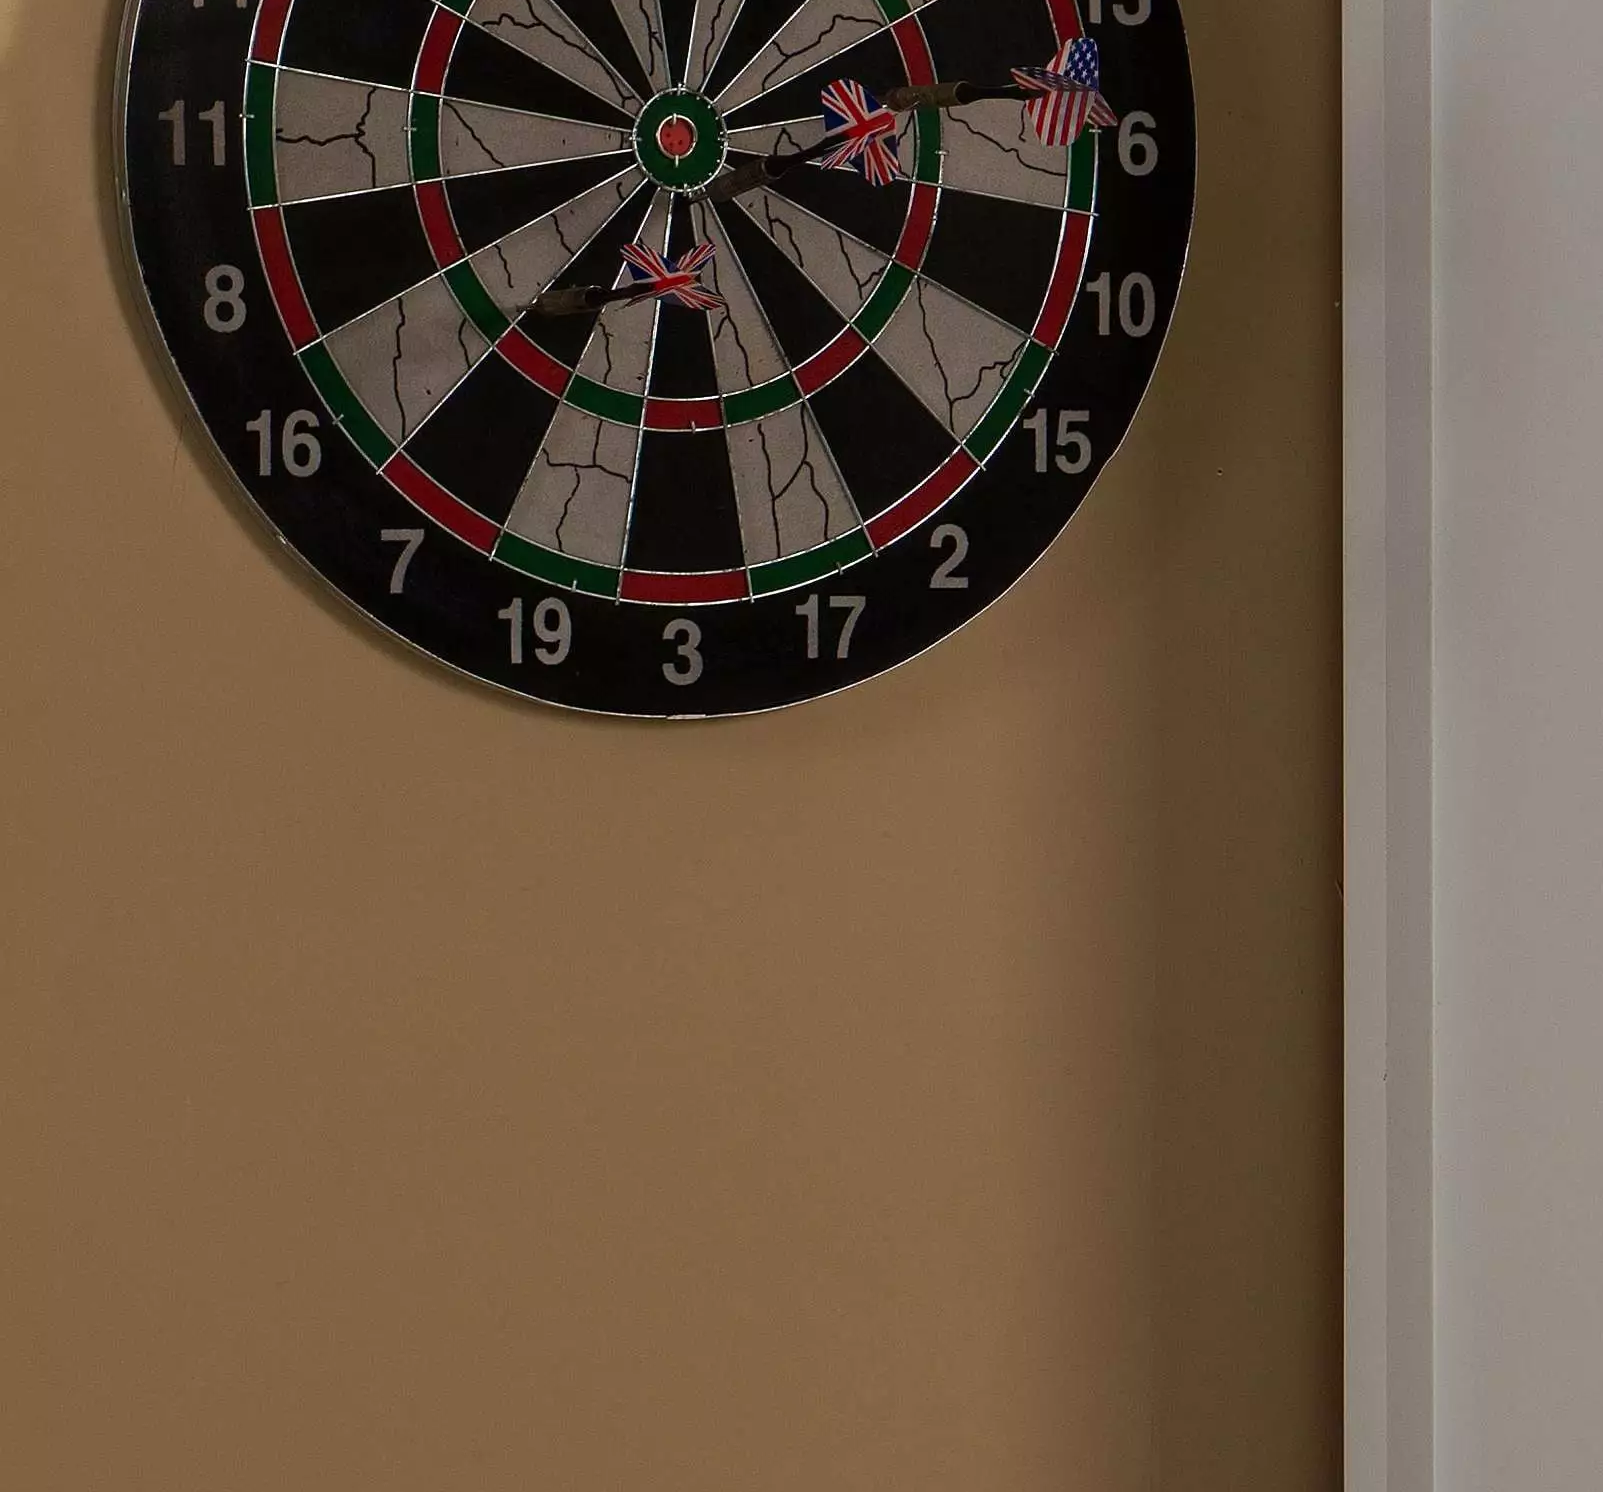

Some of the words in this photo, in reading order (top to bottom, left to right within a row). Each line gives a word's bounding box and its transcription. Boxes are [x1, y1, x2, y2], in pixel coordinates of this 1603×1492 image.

[160, 101, 225, 165] 11
[1118, 112, 1158, 176] 6
[204, 265, 246, 332] 8
[1086, 272, 1156, 337] 10
[246, 409, 321, 477] 16
[1023, 408, 1091, 474] 15
[381, 529, 424, 593] 7
[930, 524, 969, 589] 2
[498, 597, 572, 665] 19
[662, 618, 702, 685] 3
[796, 594, 866, 659] 17
